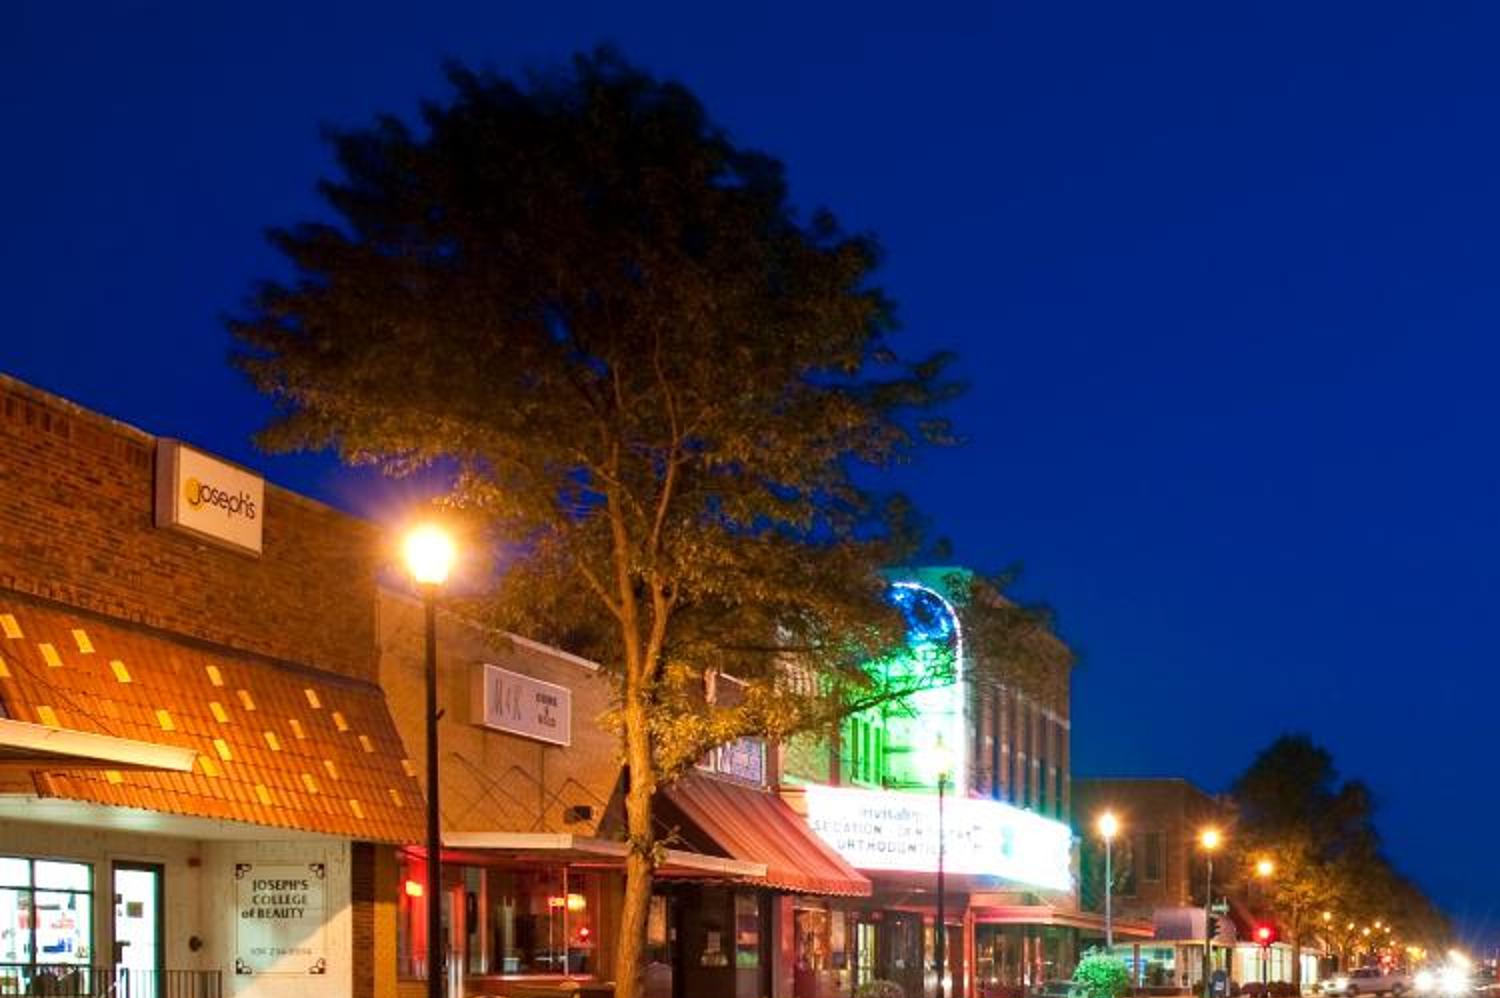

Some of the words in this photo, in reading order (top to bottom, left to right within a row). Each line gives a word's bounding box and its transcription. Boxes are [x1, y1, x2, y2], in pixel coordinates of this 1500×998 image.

[252, 879, 309, 892] JOSEPH'S
[251, 894, 307, 905] COLLEGE
[257, 907, 305, 919] BEAUTY
